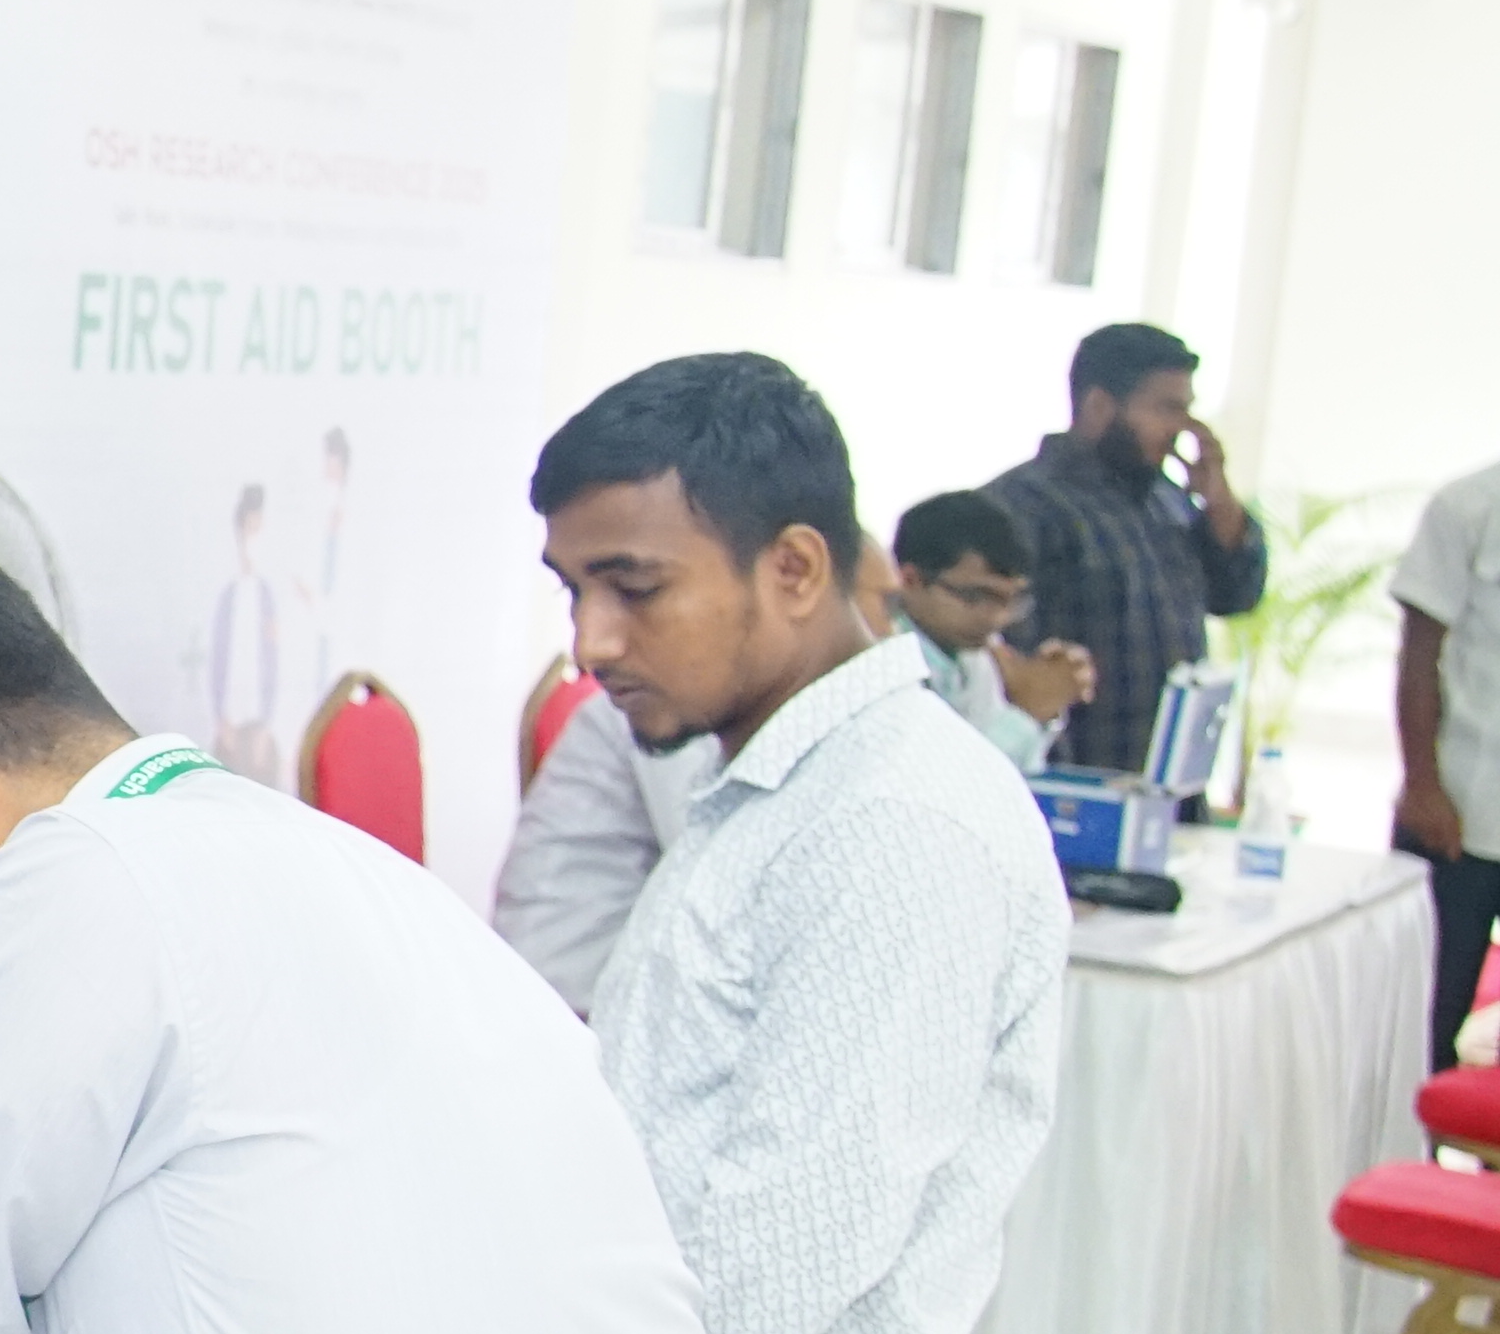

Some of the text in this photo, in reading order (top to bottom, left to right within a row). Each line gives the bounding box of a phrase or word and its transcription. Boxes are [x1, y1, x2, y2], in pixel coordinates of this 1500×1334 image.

[70, 271, 487, 377] FIRST AID BOOTH
